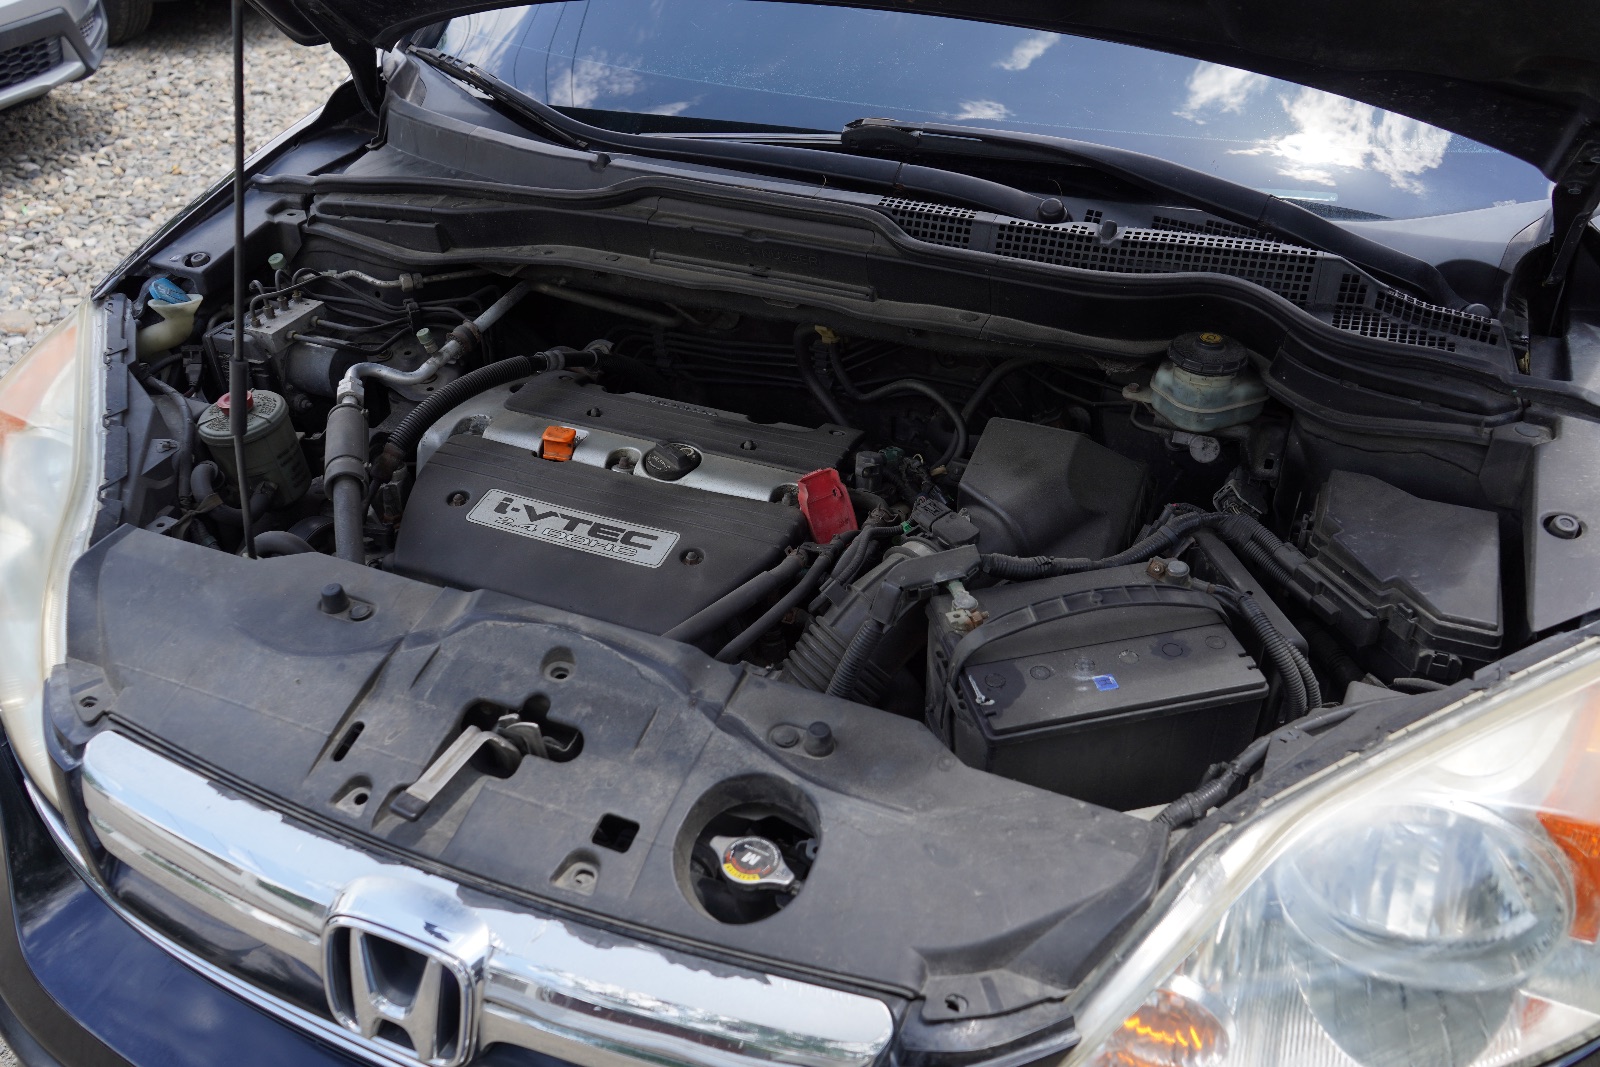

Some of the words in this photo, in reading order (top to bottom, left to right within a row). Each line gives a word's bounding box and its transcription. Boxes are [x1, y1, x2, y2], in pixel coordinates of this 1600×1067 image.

[704, 239, 751, 255] FRAME
[761, 249, 818, 266] NUMBER
[493, 496, 660, 550] i-VTEC
